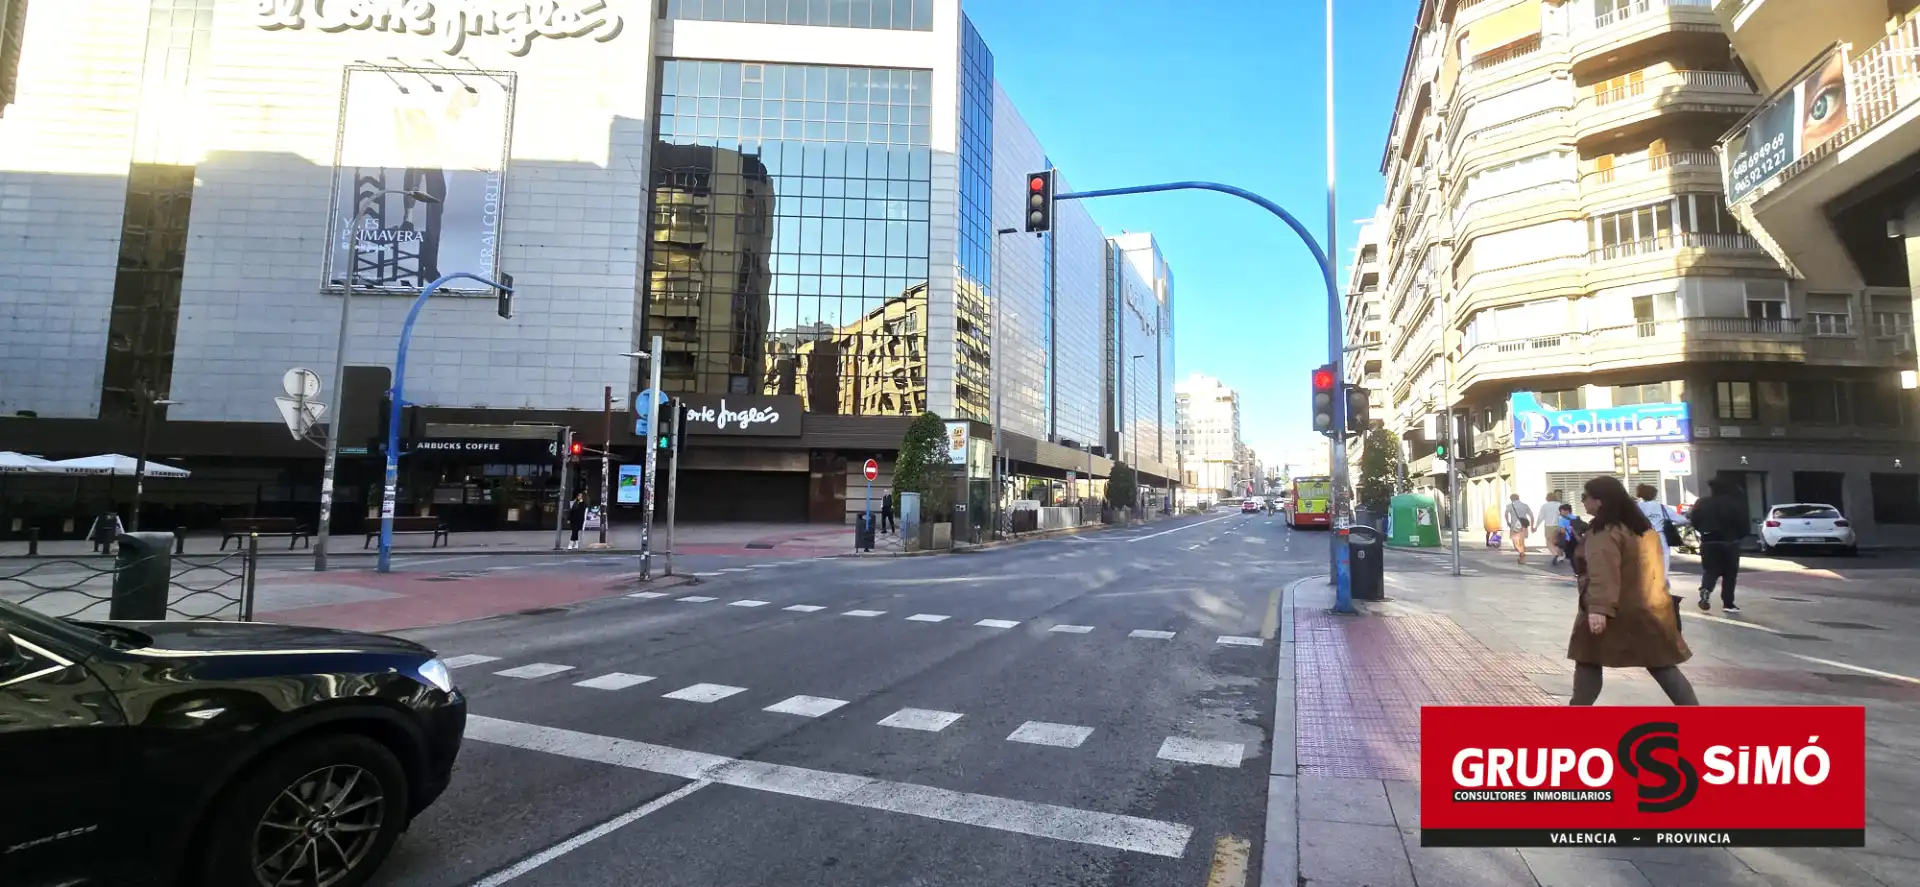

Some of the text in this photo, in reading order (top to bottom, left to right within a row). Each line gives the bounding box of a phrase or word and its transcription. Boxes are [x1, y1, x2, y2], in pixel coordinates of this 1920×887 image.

[1772, 132, 1784, 149] 69
[1750, 168, 1762, 182] 92
[1762, 159, 1773, 173] 12
[1773, 149, 1785, 166] 27
[364, 218, 380, 230] ES
[685, 399, 780, 430] orte Inglés
[415, 441, 500, 450] ARBUCKS COFFEE
